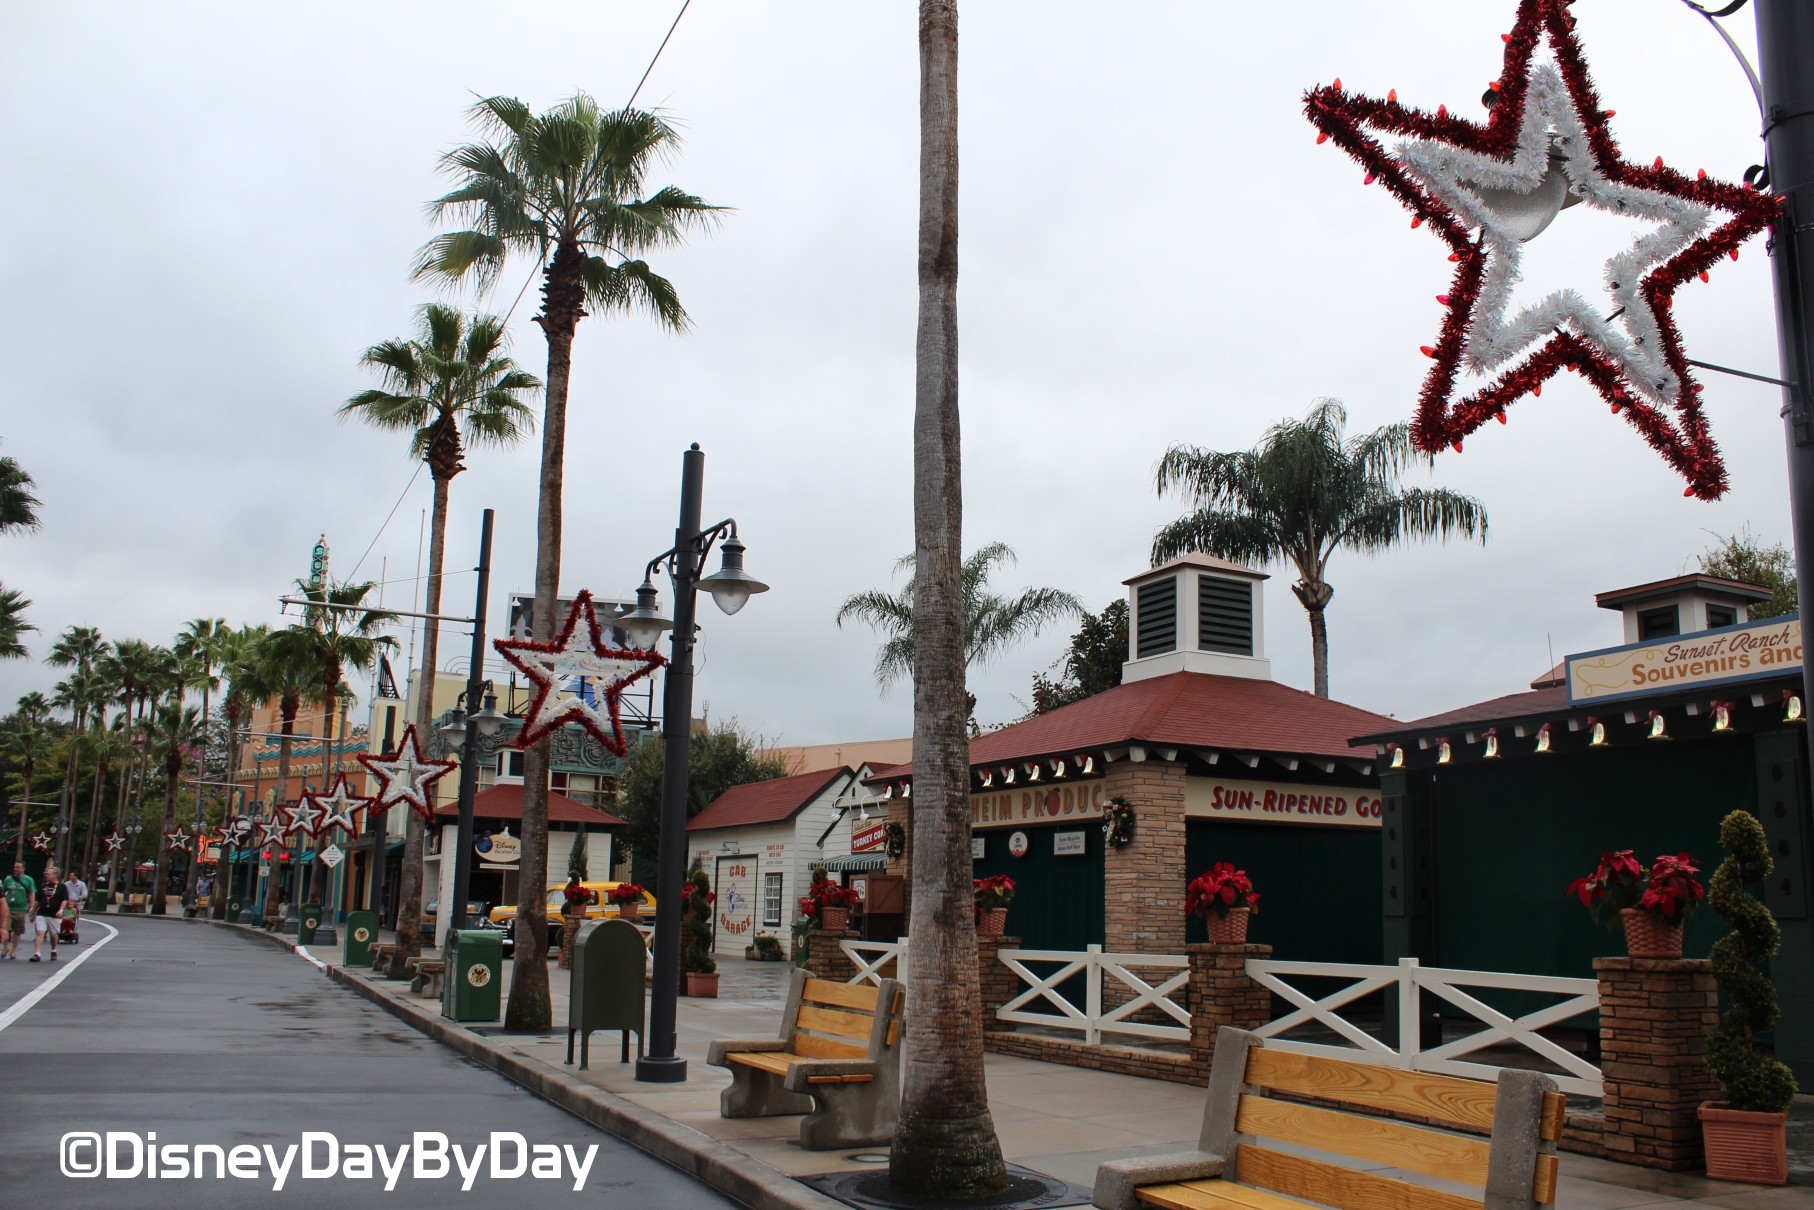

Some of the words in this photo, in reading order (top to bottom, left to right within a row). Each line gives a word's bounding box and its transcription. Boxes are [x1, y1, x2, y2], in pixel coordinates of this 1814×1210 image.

[1664, 637, 1727, 664] Sunset
[1729, 624, 1790, 653] Ranch
[1631, 650, 1751, 686] Souvenirs
[1210, 785, 1348, 816] SUN-RIPENED
[494, 840, 516, 851] Disney
[853, 833, 873, 849] TURKEY
[729, 864, 747, 878] CAB
[721, 913, 752, 935] GARAGE
